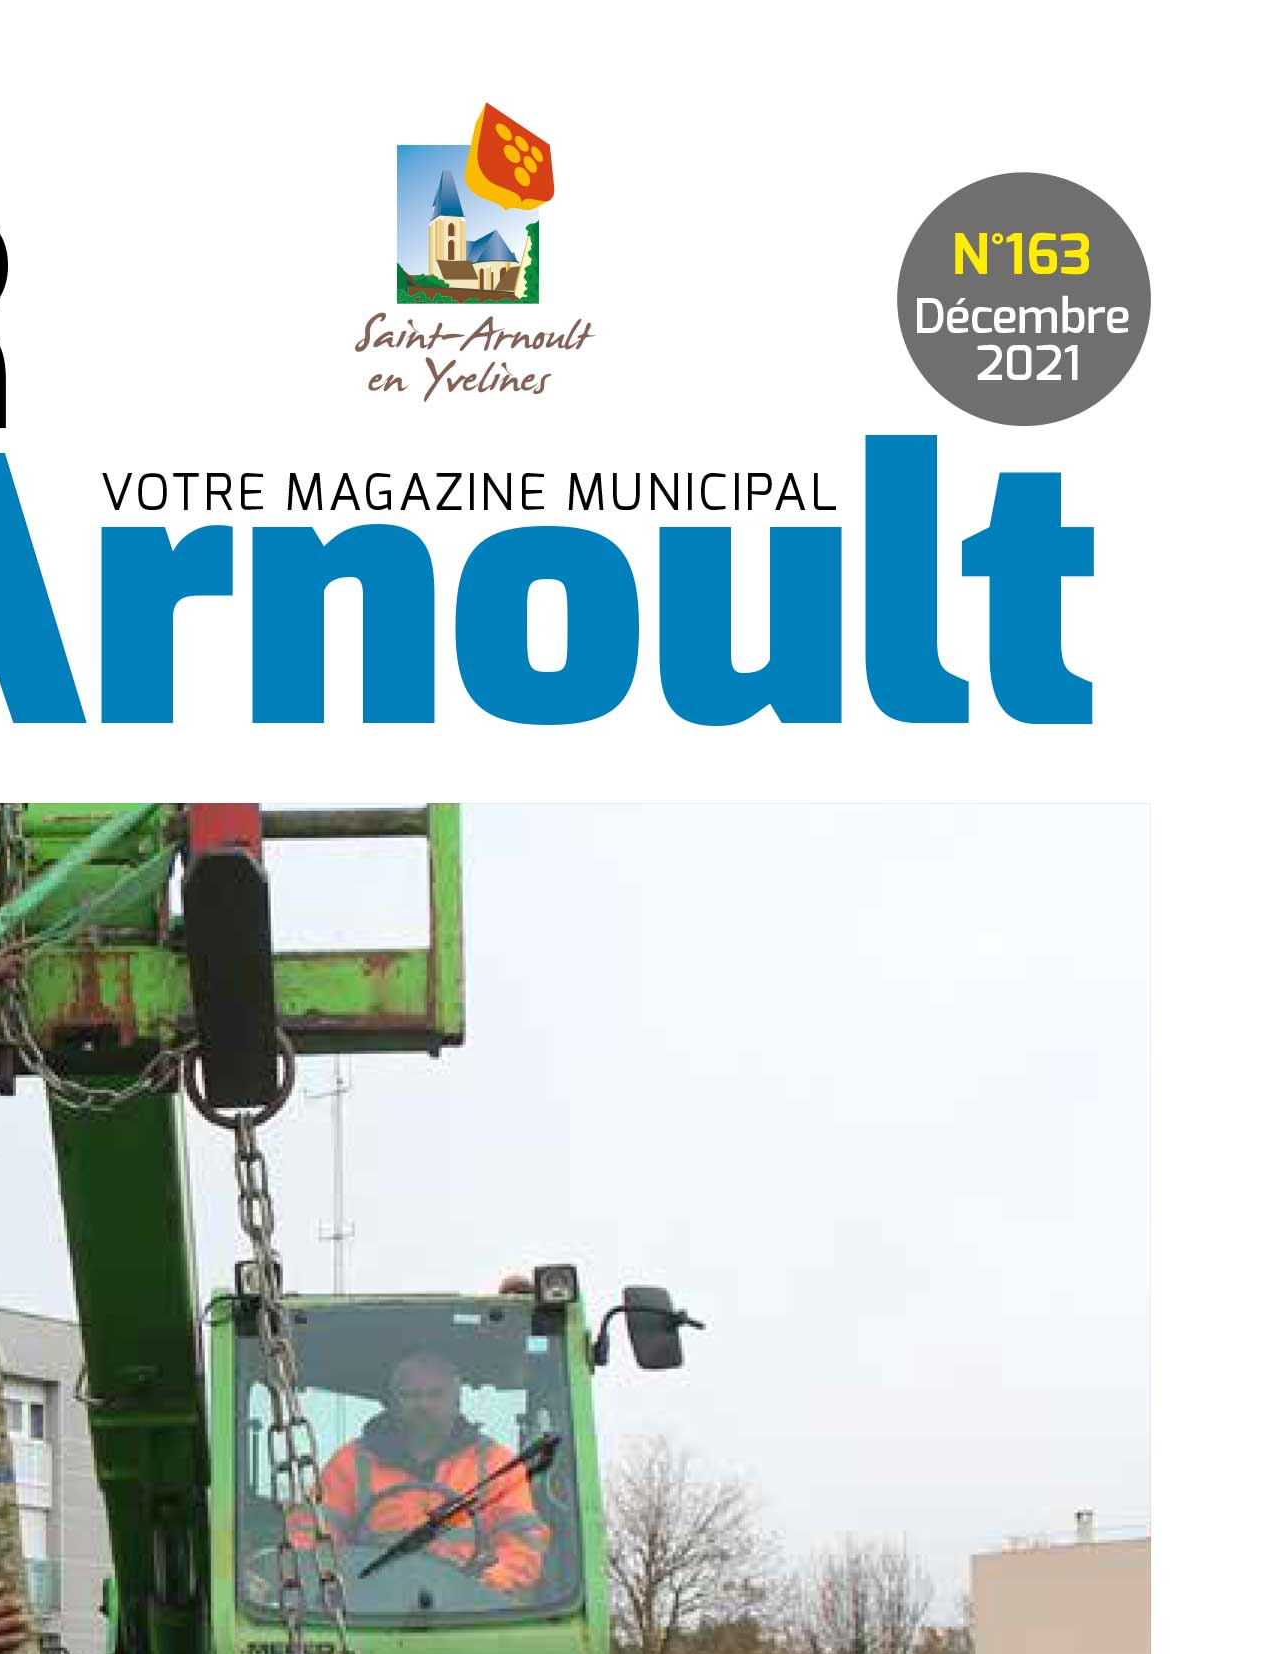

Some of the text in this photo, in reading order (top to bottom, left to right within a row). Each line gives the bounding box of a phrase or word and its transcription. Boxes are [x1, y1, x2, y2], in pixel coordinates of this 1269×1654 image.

[954, 232, 1090, 275] N°163
[355, 313, 595, 352] Saint-Arnoult
[917, 296, 1130, 333] Décembre
[368, 357, 551, 402] en Yvelines
[977, 345, 1078, 381] 2021
[102, 473, 836, 510] VOTRE MAGAZINE MUNICIPAL
